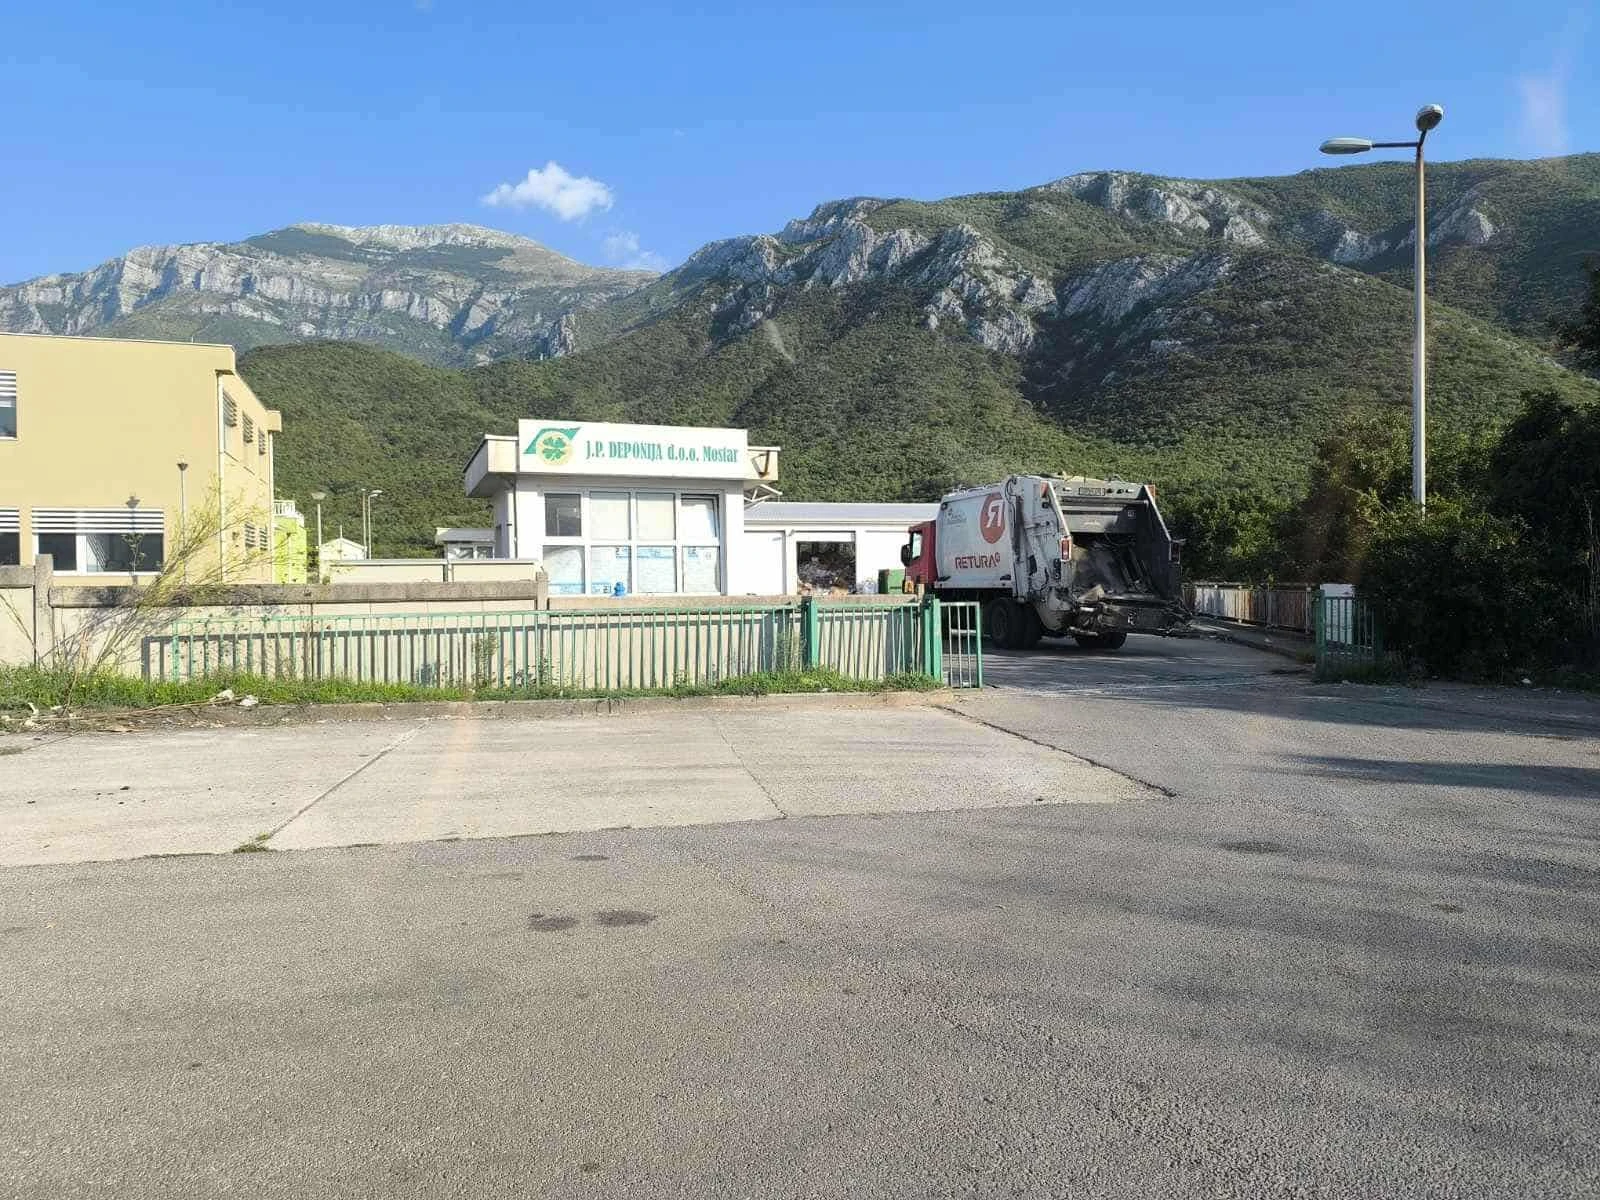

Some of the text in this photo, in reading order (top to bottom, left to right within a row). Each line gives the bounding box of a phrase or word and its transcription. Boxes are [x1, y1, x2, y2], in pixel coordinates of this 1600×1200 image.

[586, 440, 739, 463] J.P. DEPONIJA d.o.o. Mostar
